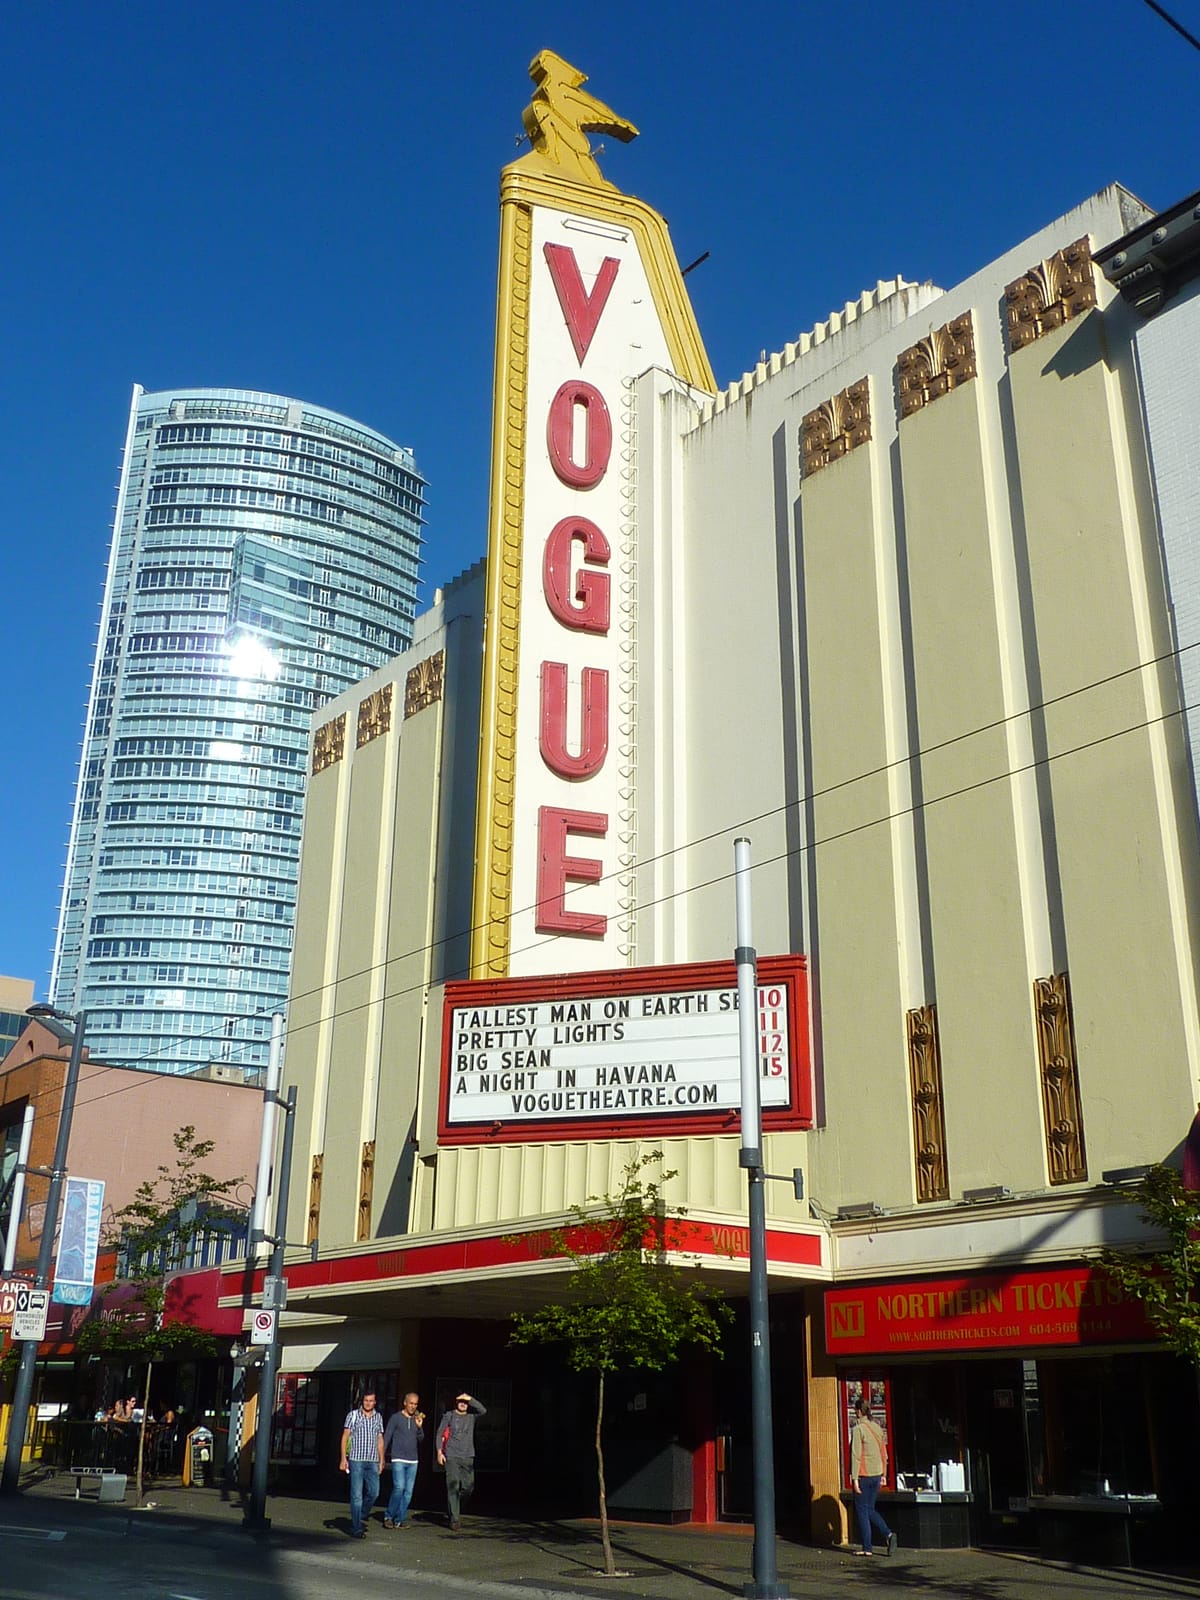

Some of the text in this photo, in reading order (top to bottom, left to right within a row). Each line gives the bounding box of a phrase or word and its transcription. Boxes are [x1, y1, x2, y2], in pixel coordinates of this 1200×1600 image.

[536, 241, 621, 941] VOGUE
[457, 1007, 538, 1029] TALLEST
[551, 1003, 591, 1023] MAN
[603, 1000, 630, 1019] ON
[642, 994, 708, 1017] EARTH
[759, 989, 782, 1008] 10
[458, 1012, 778, 1050] PRETTY LIGHTS 11
[457, 1034, 783, 1072] BIG SEAN 12
[456, 1057, 783, 1094] A NIGHT IN HAVANA 15
[511, 1084, 718, 1113] VOGUETHEATRE.COM
[877, 1287, 1004, 1321] NORTHERN
[1010, 1278, 1123, 1313] TICKETS
[832, 1302, 864, 1336] NT
[889, 1325, 1021, 1343] WWW.NORTHERNTICKETS.COM
